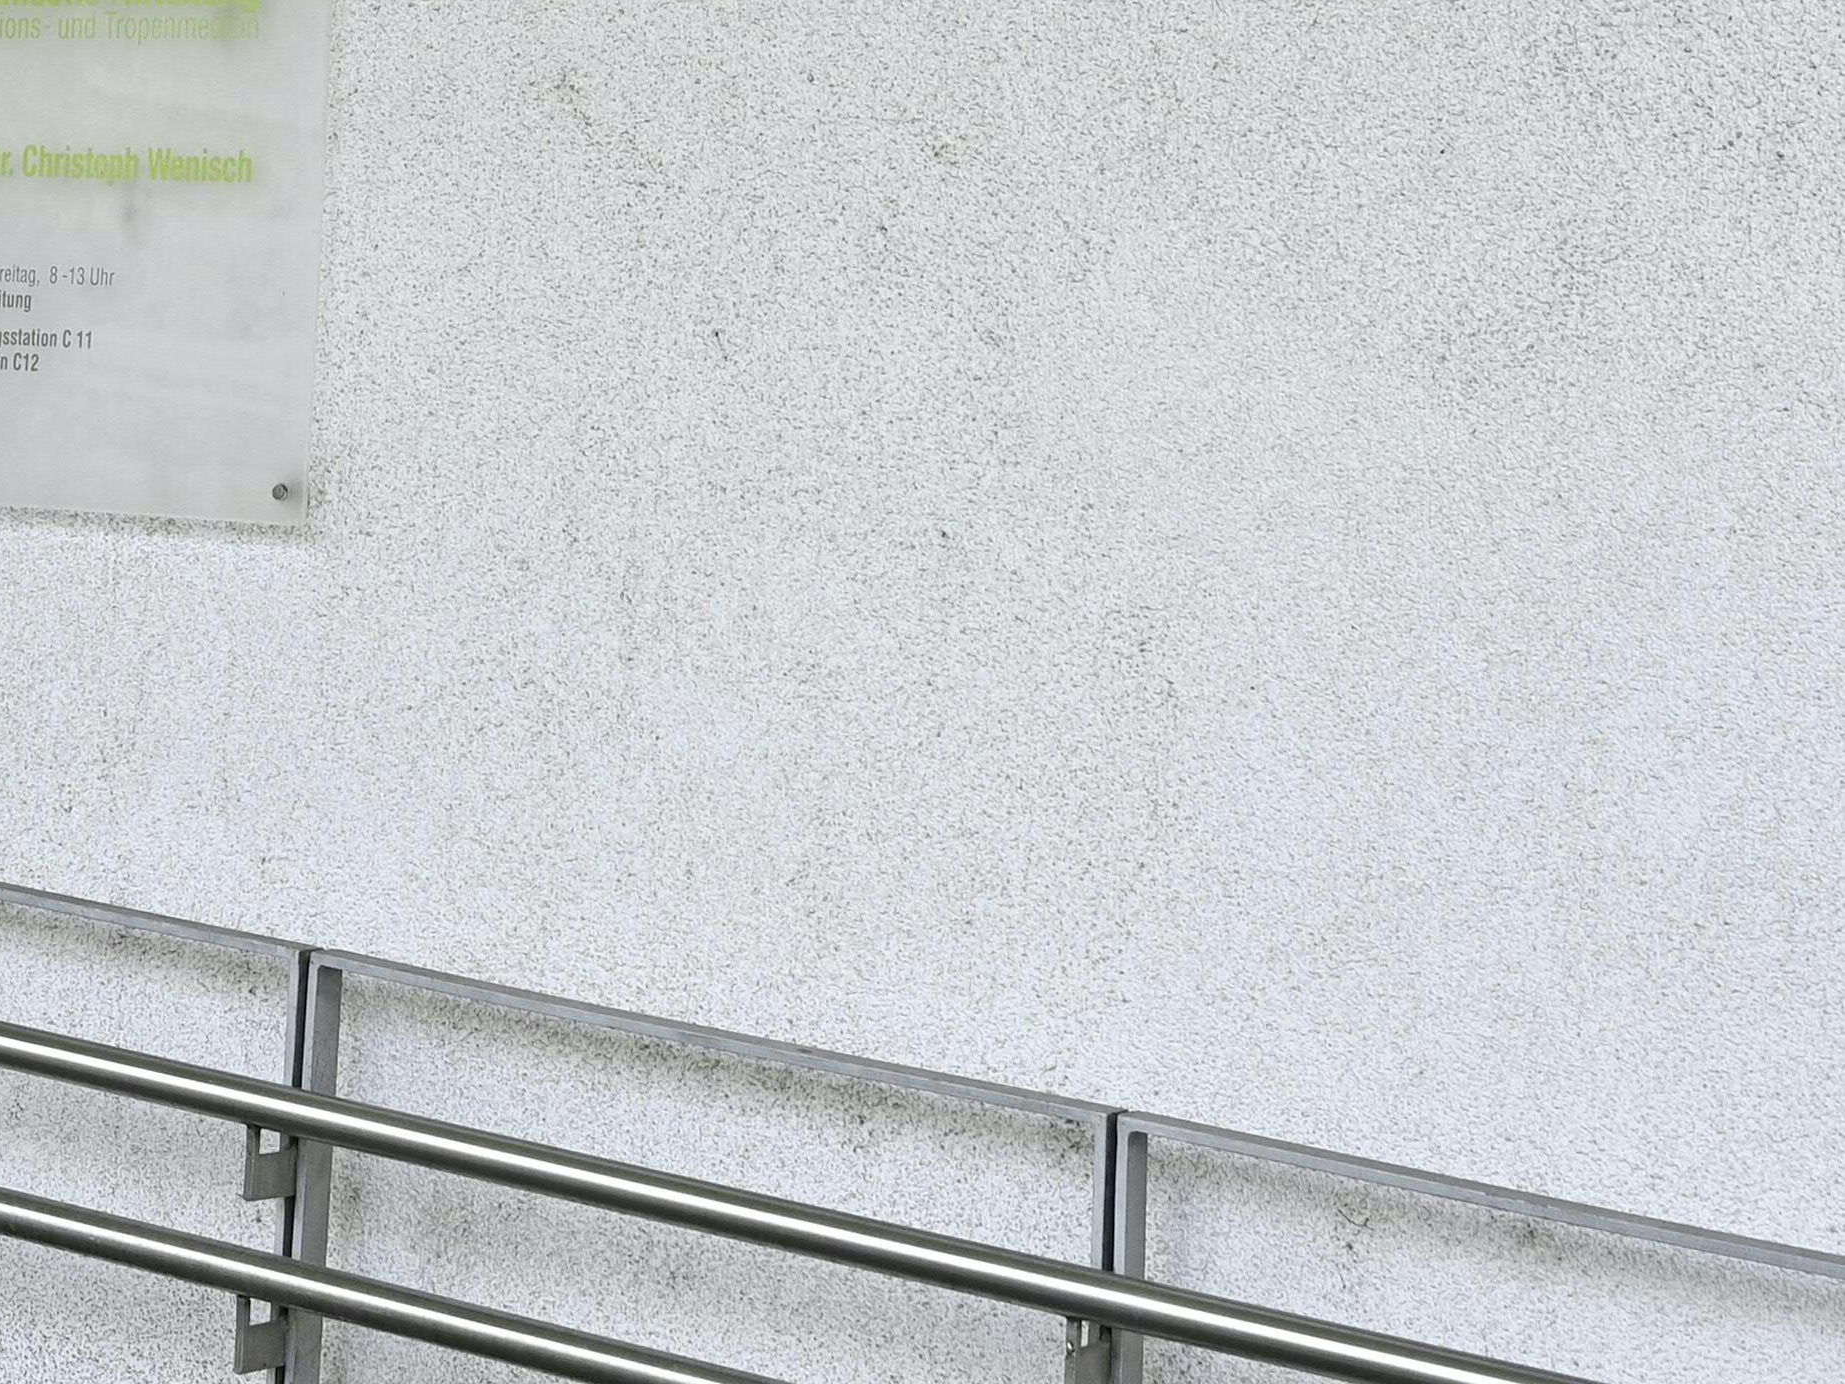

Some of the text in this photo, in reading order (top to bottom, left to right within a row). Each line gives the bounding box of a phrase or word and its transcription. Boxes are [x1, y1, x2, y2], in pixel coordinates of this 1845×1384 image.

[58, 16, 96, 39] und
[22, 144, 138, 185] Christoph
[147, 147, 253, 183] Wenisch
[49, 266, 57, 284] 8
[90, 267, 115, 286] Uhr
[62, 330, 71, 348] C
[76, 331, 92, 349] 11
[13, 353, 39, 371] C12
